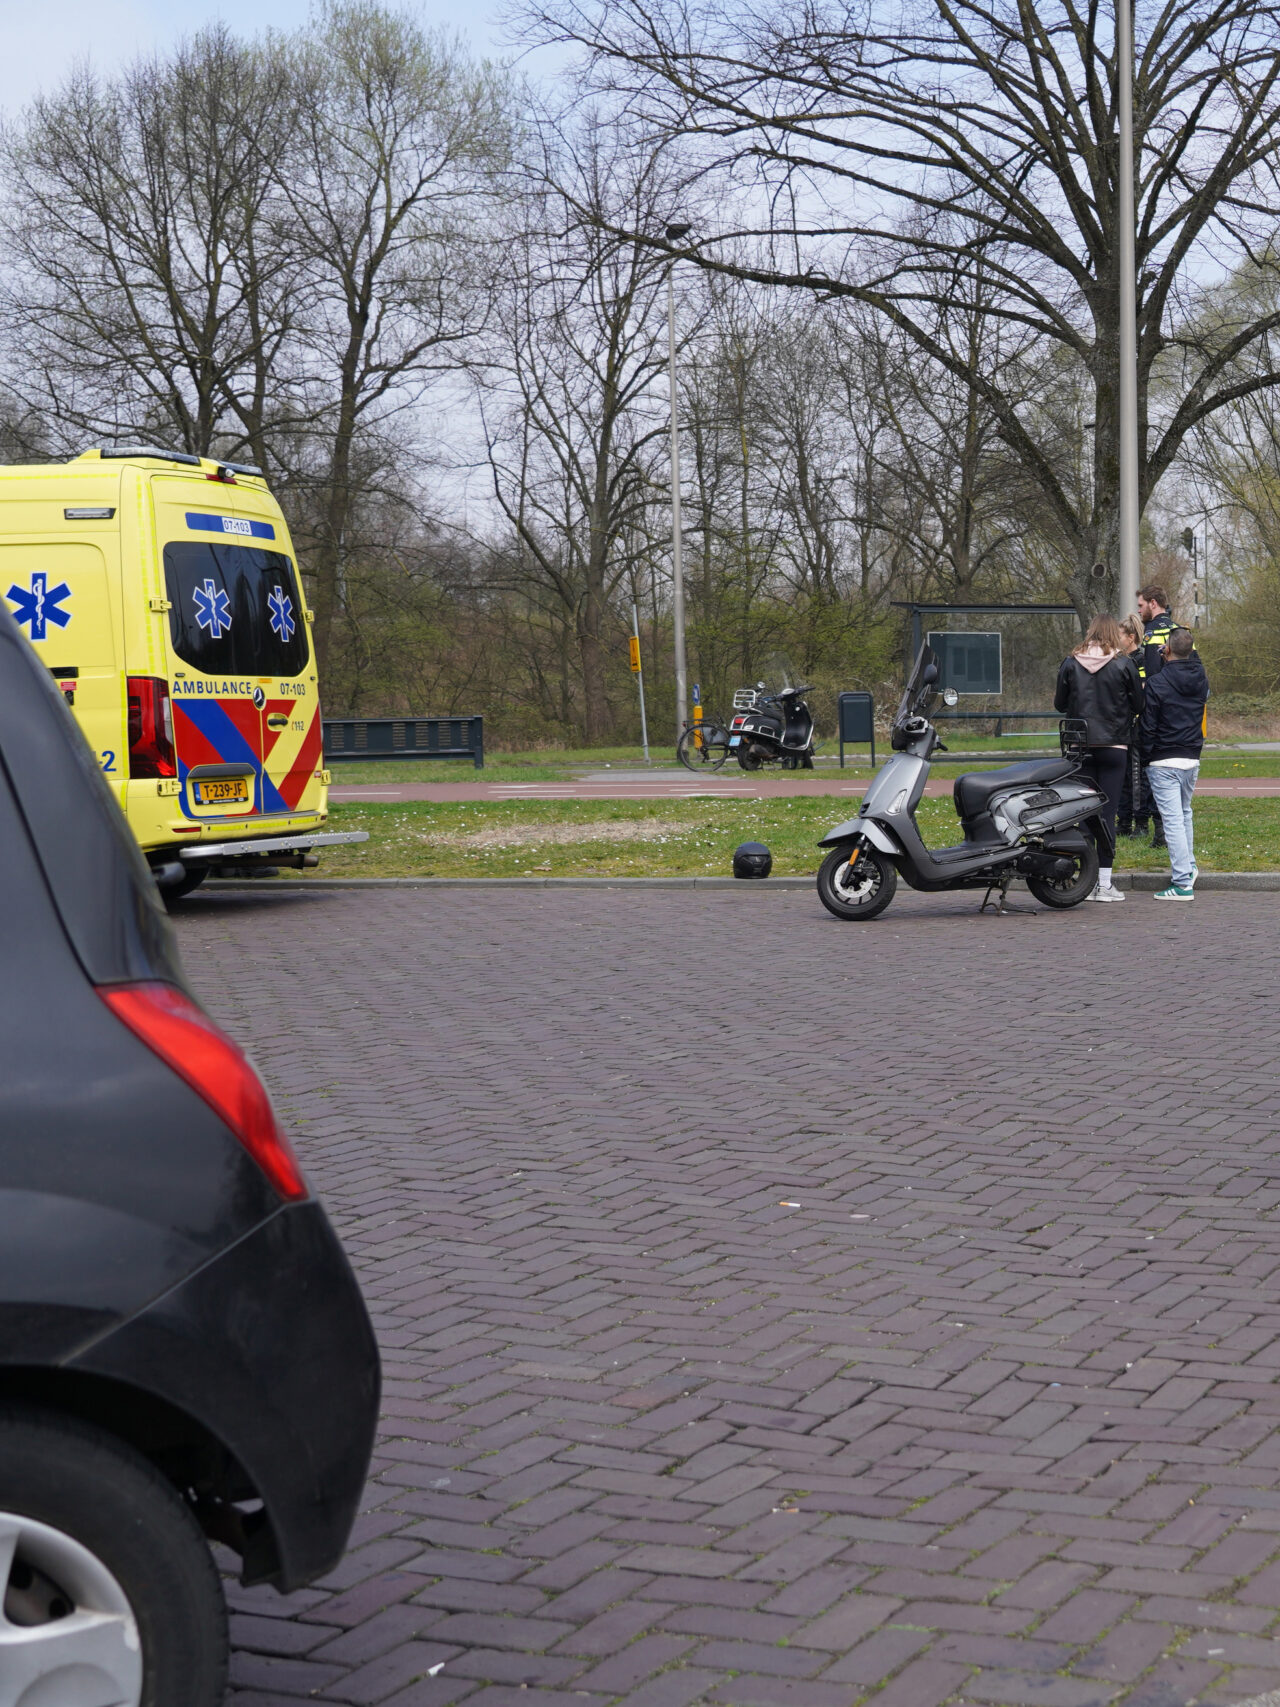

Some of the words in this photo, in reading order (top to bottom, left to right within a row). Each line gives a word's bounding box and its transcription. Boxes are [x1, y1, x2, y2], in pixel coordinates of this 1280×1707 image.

[223, 520, 250, 533] 07-103
[172, 681, 252, 695] AMBULANCE
[280, 683, 306, 696] 07-103
[203, 782, 243, 798] T-239-JF
